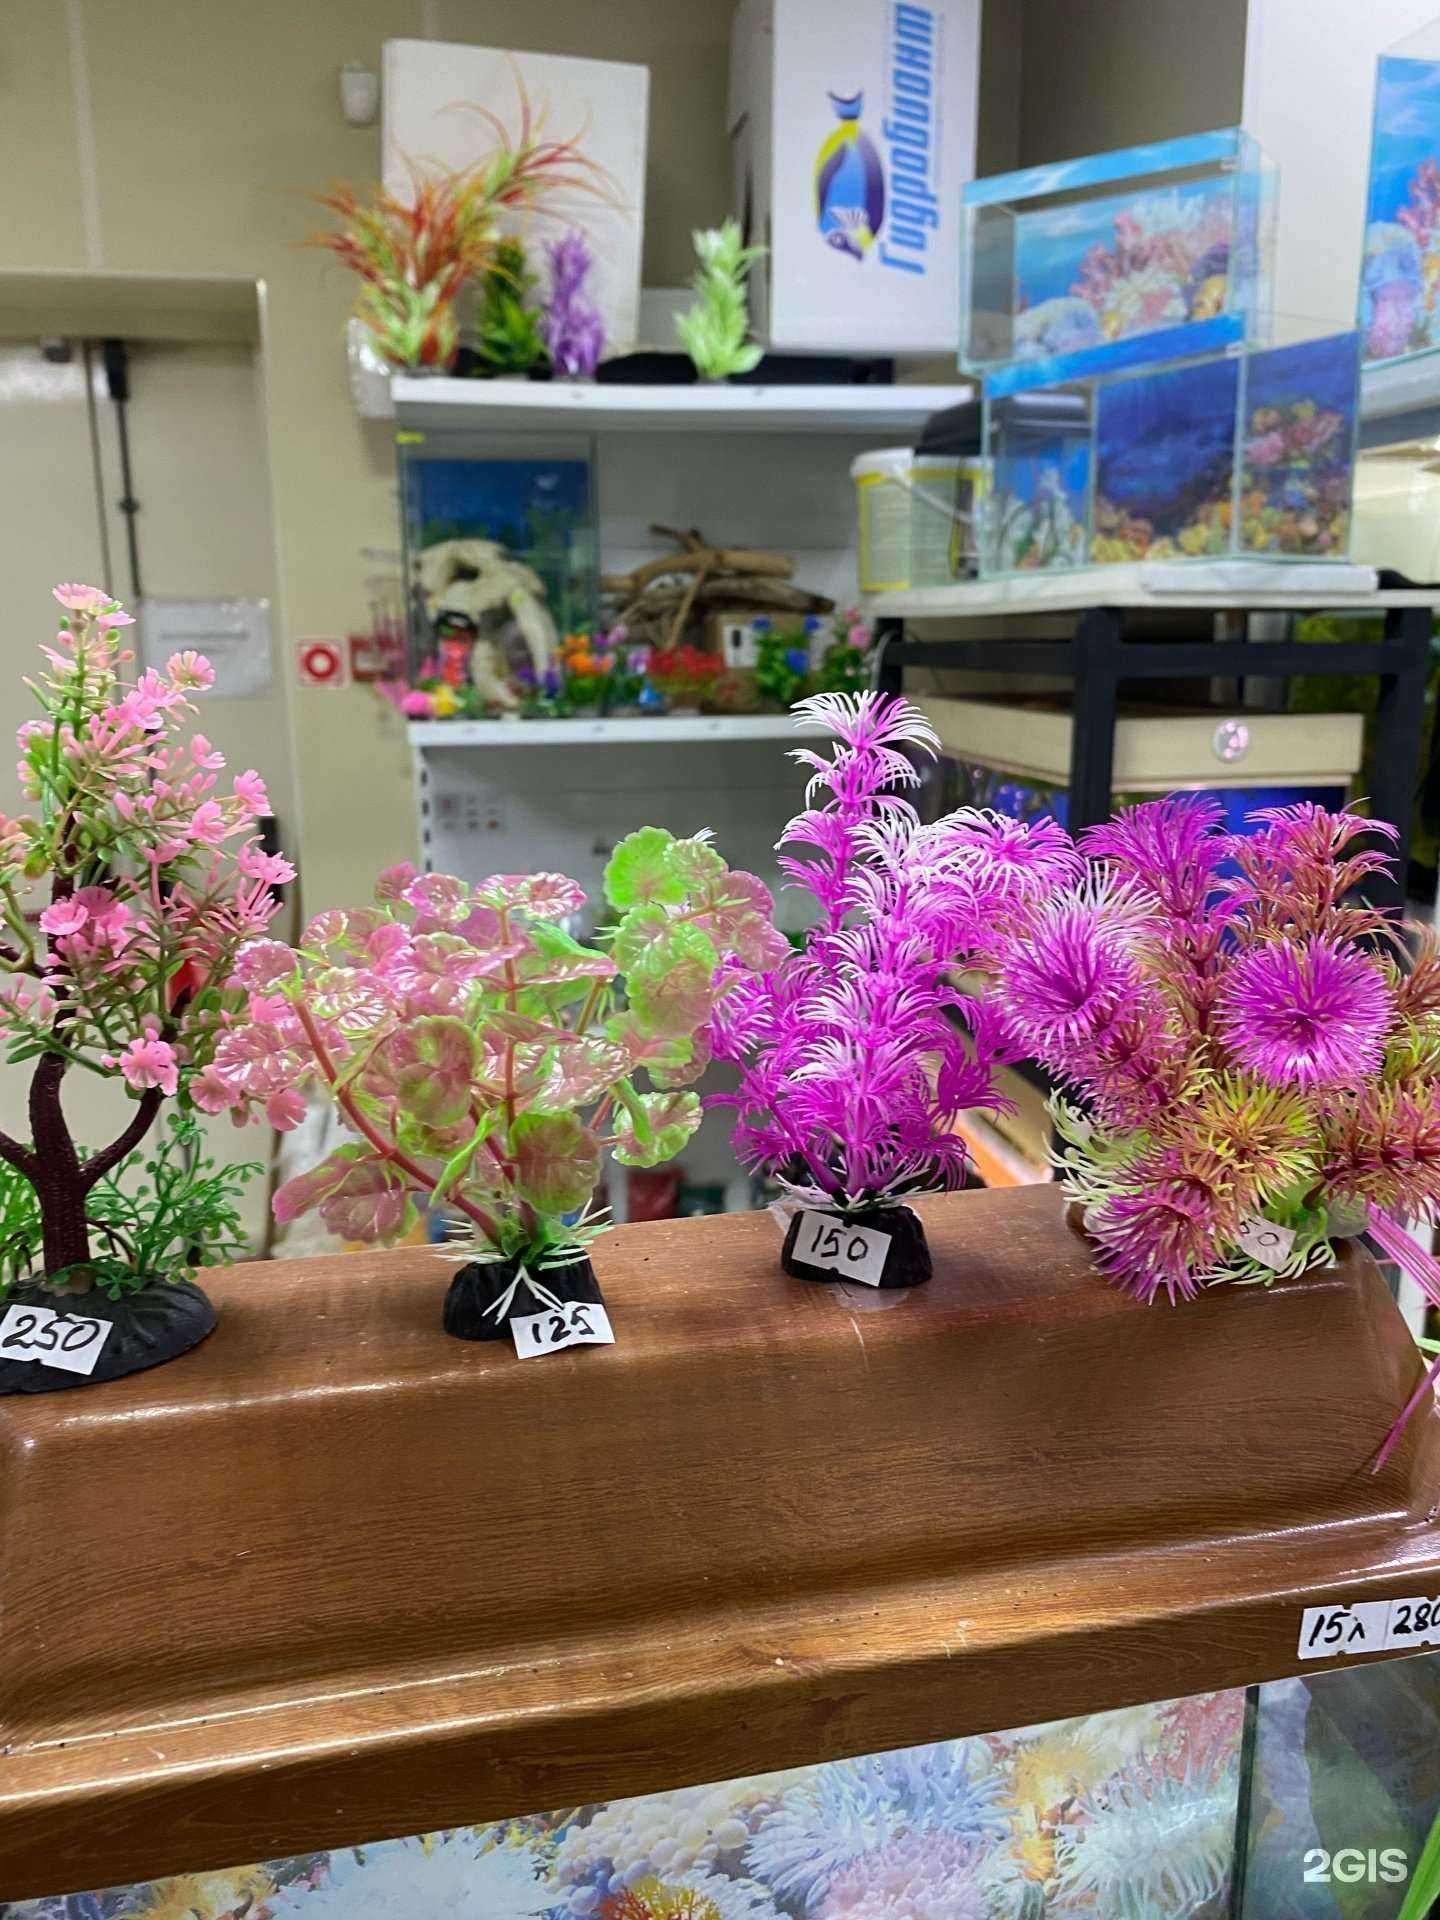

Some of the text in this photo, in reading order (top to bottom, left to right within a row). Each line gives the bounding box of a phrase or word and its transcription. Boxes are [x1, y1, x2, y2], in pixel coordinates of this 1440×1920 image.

[878, 2, 940, 275] Гидробионт
[811, 1224, 868, 1261] 150
[2, 1314, 100, 1352] 250
[532, 1305, 596, 1344] 125
